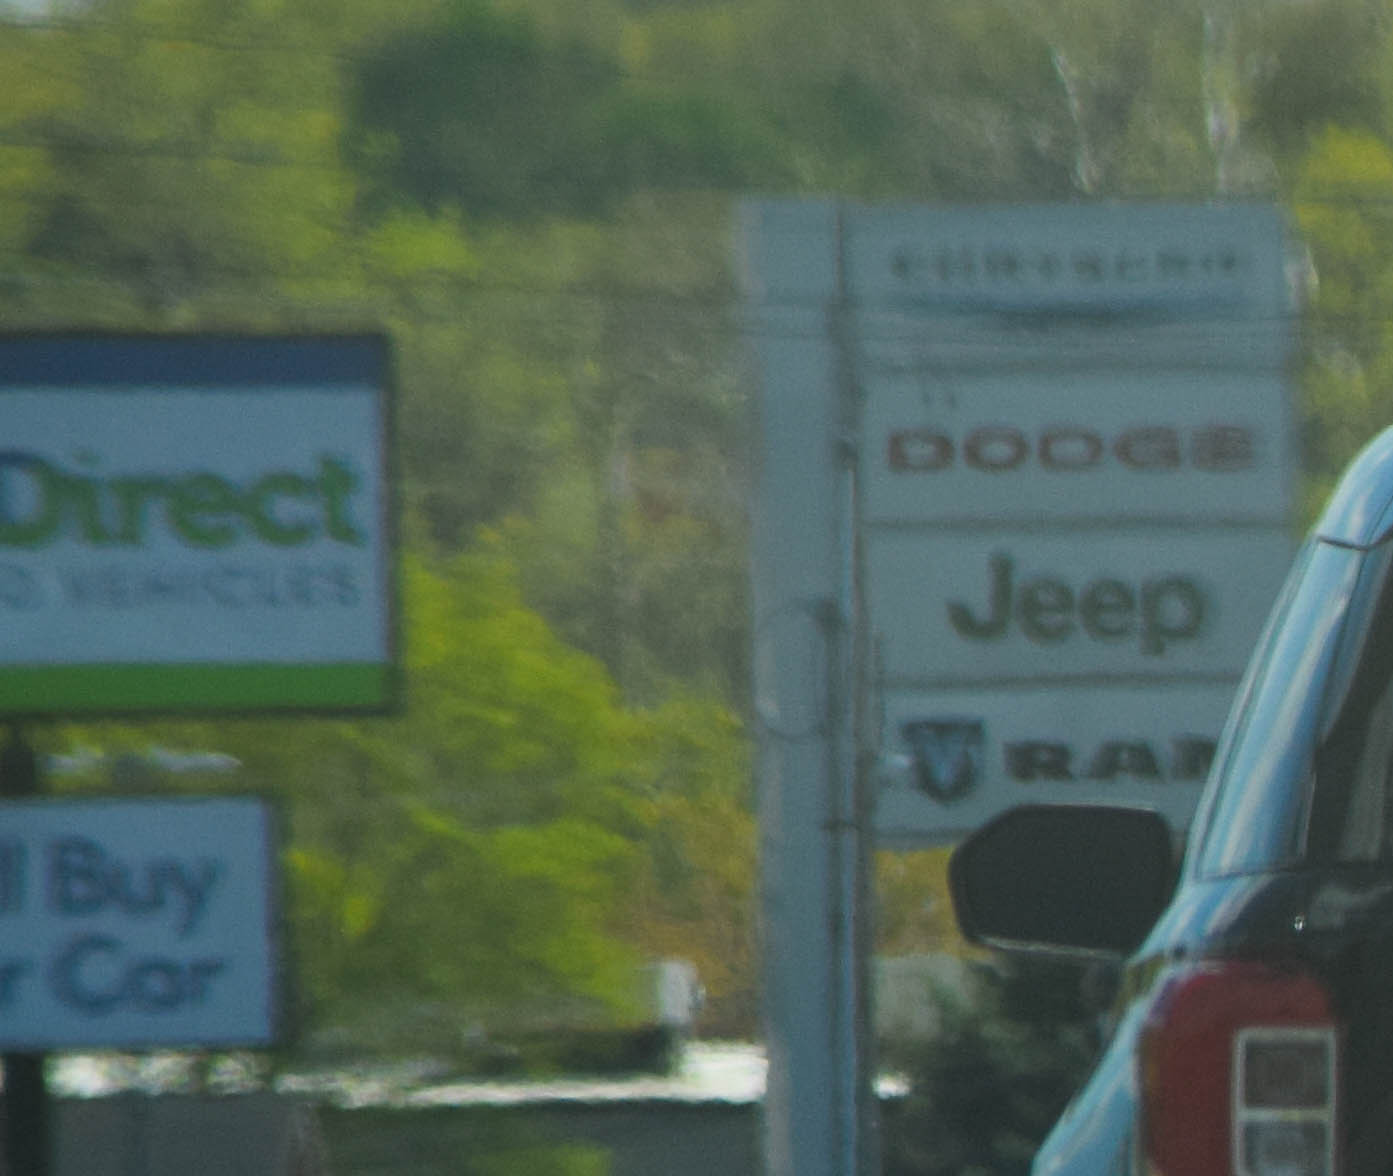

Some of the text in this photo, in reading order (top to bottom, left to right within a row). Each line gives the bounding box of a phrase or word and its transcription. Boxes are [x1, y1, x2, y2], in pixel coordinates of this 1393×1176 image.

[0, 447, 365, 549] Direct
[888, 424, 1253, 471] DODGE
[947, 550, 1207, 656] Jeep
[47, 834, 227, 939] Buy
[51, 931, 228, 1016] Car
